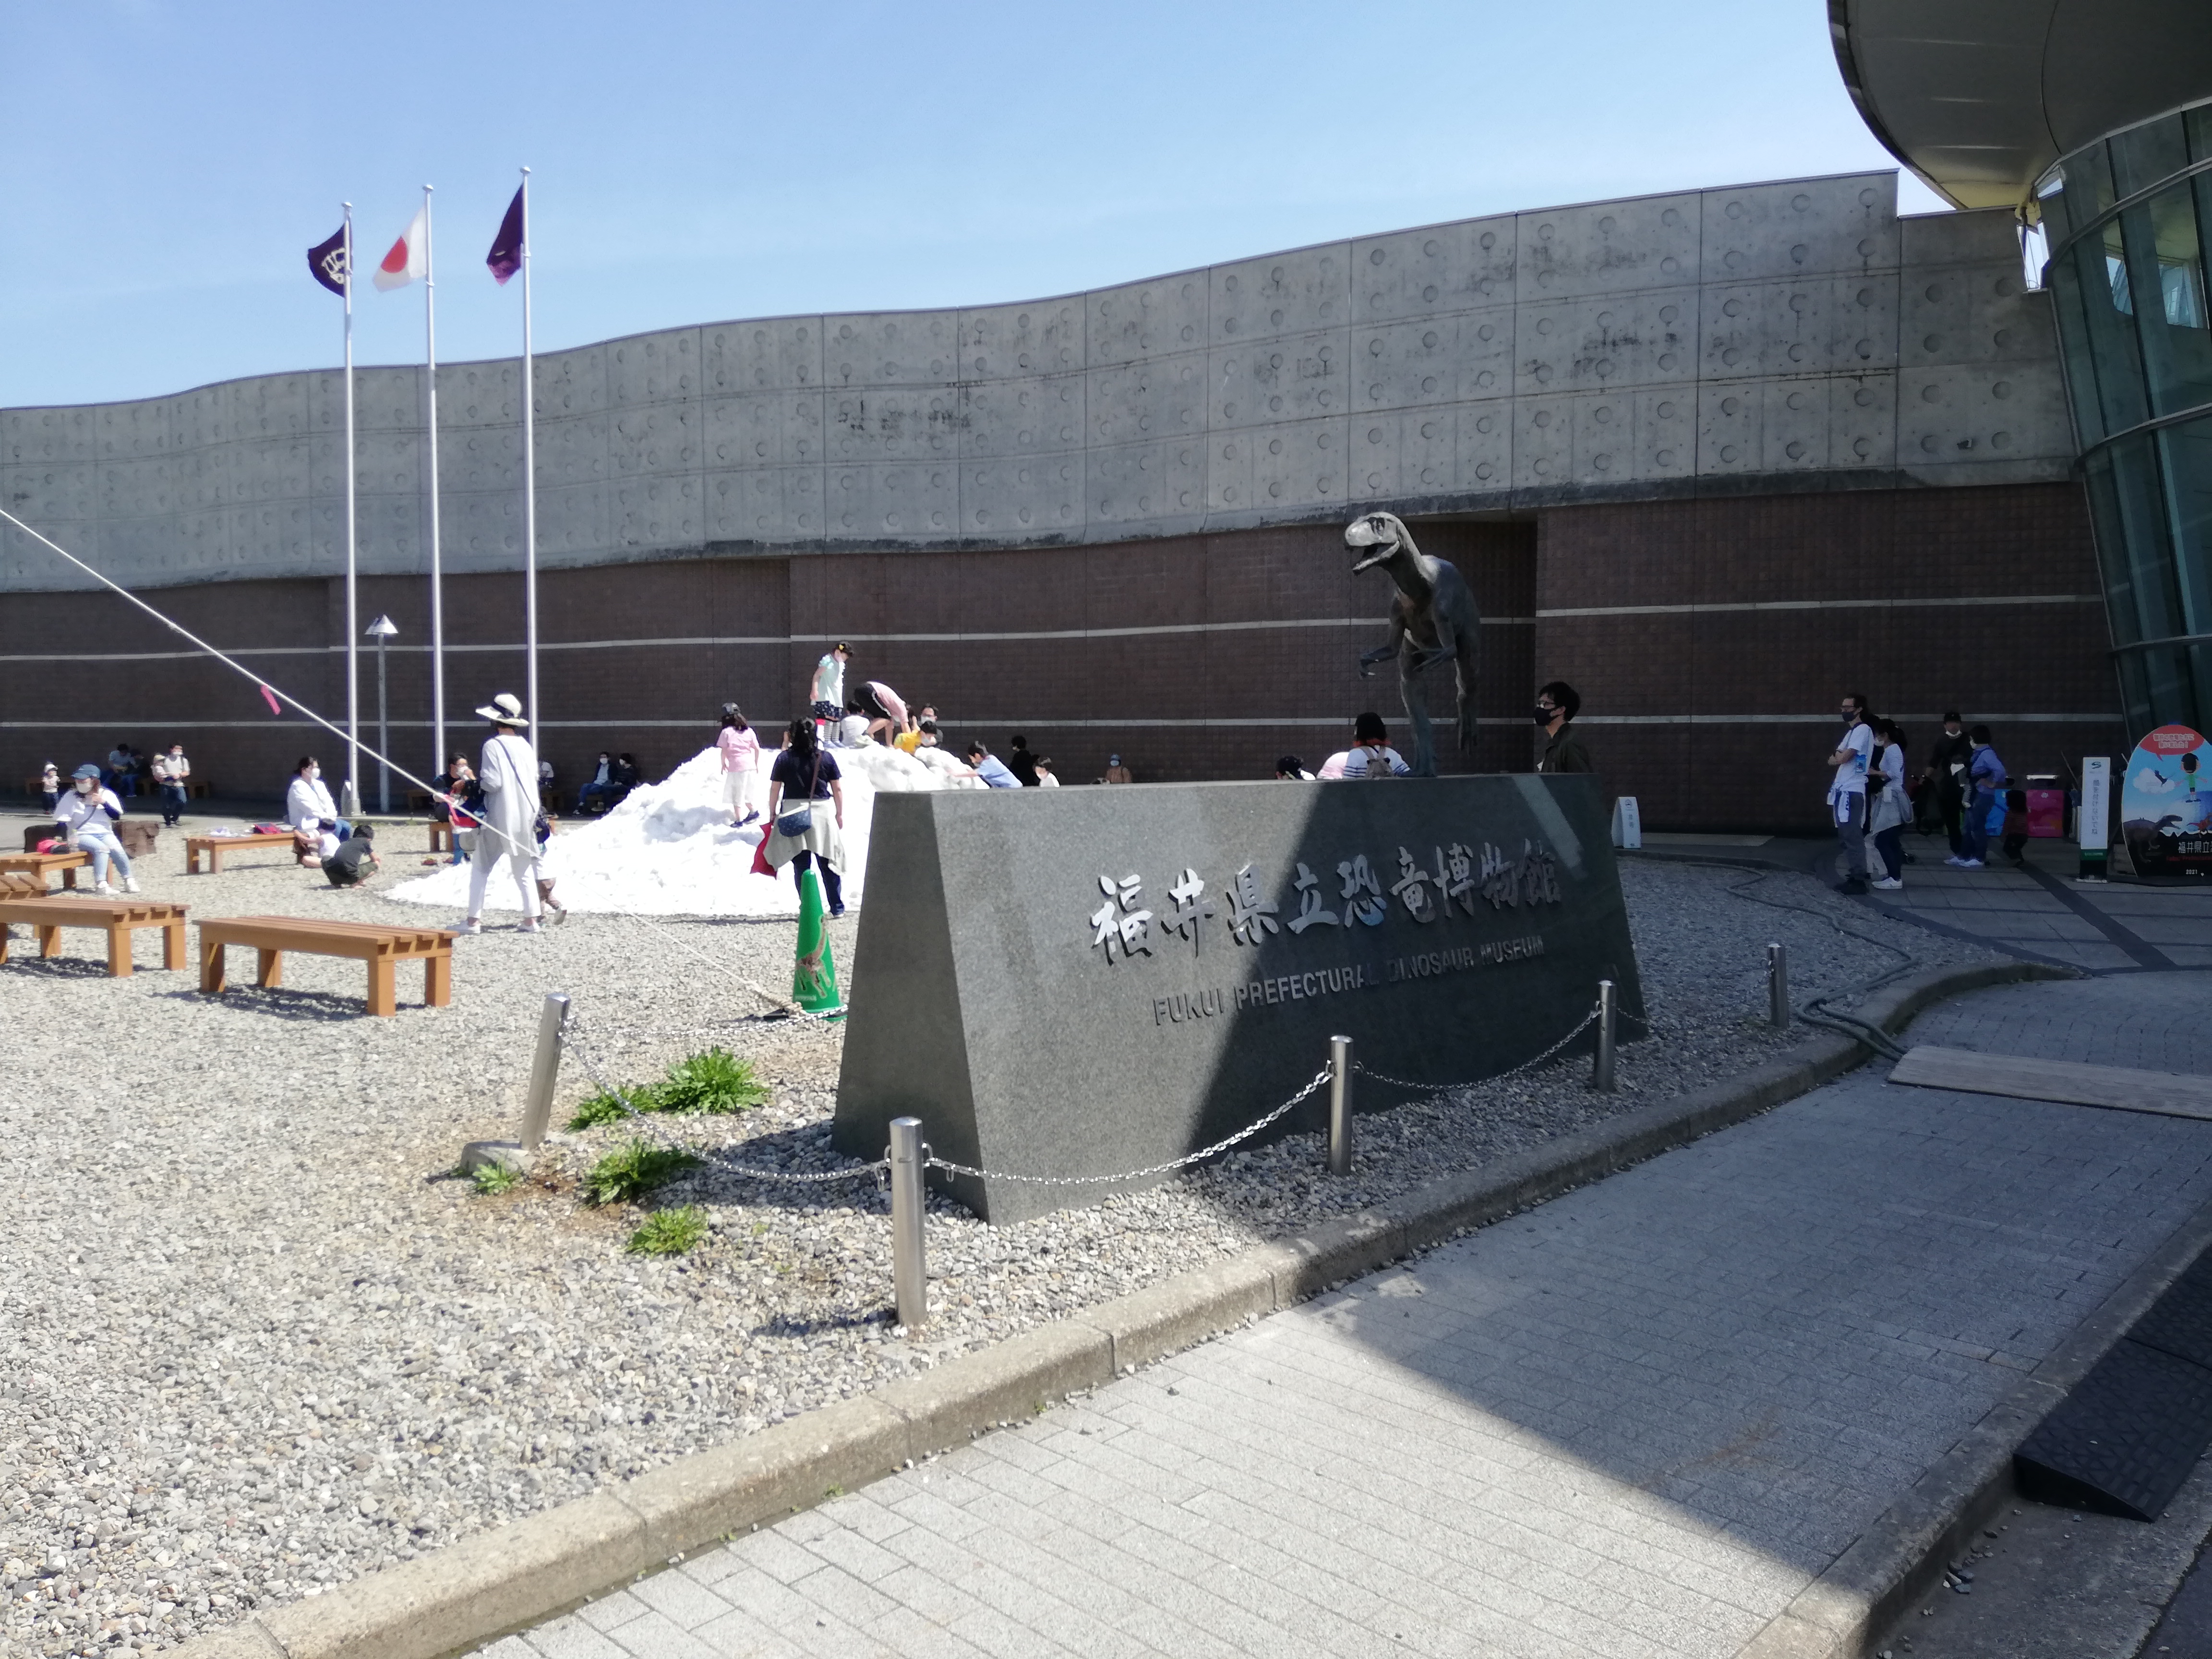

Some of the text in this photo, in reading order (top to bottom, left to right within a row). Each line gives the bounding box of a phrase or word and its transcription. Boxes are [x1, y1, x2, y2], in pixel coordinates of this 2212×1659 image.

[2178, 841, 2212, 854] 福井県立
[1090, 839, 1561, 966] 福井県立恐竜博物館
[1153, 935, 1545, 1026] FUKUI PREFECTURAL DINOSAUR MUSEUM
